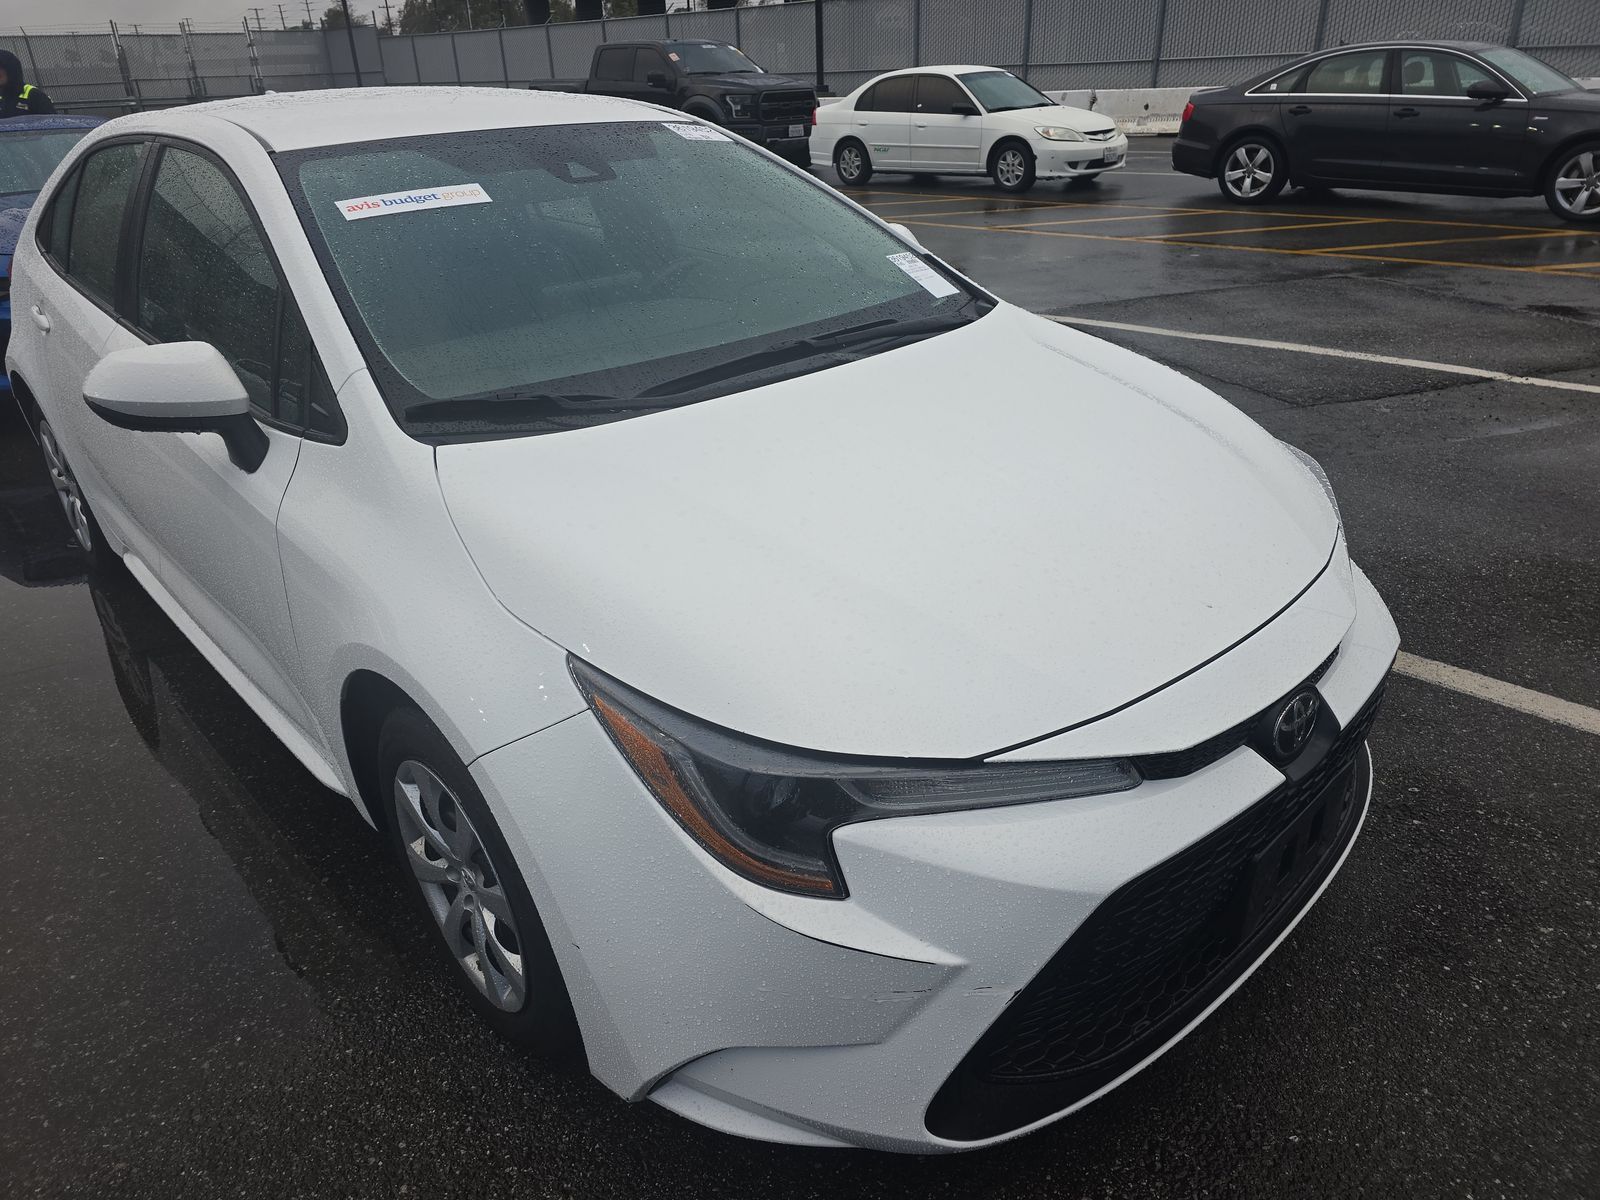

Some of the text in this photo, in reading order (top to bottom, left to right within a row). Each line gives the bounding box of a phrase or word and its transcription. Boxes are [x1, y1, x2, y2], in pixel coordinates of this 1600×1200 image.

[346, 188, 481, 212] avis budget group
